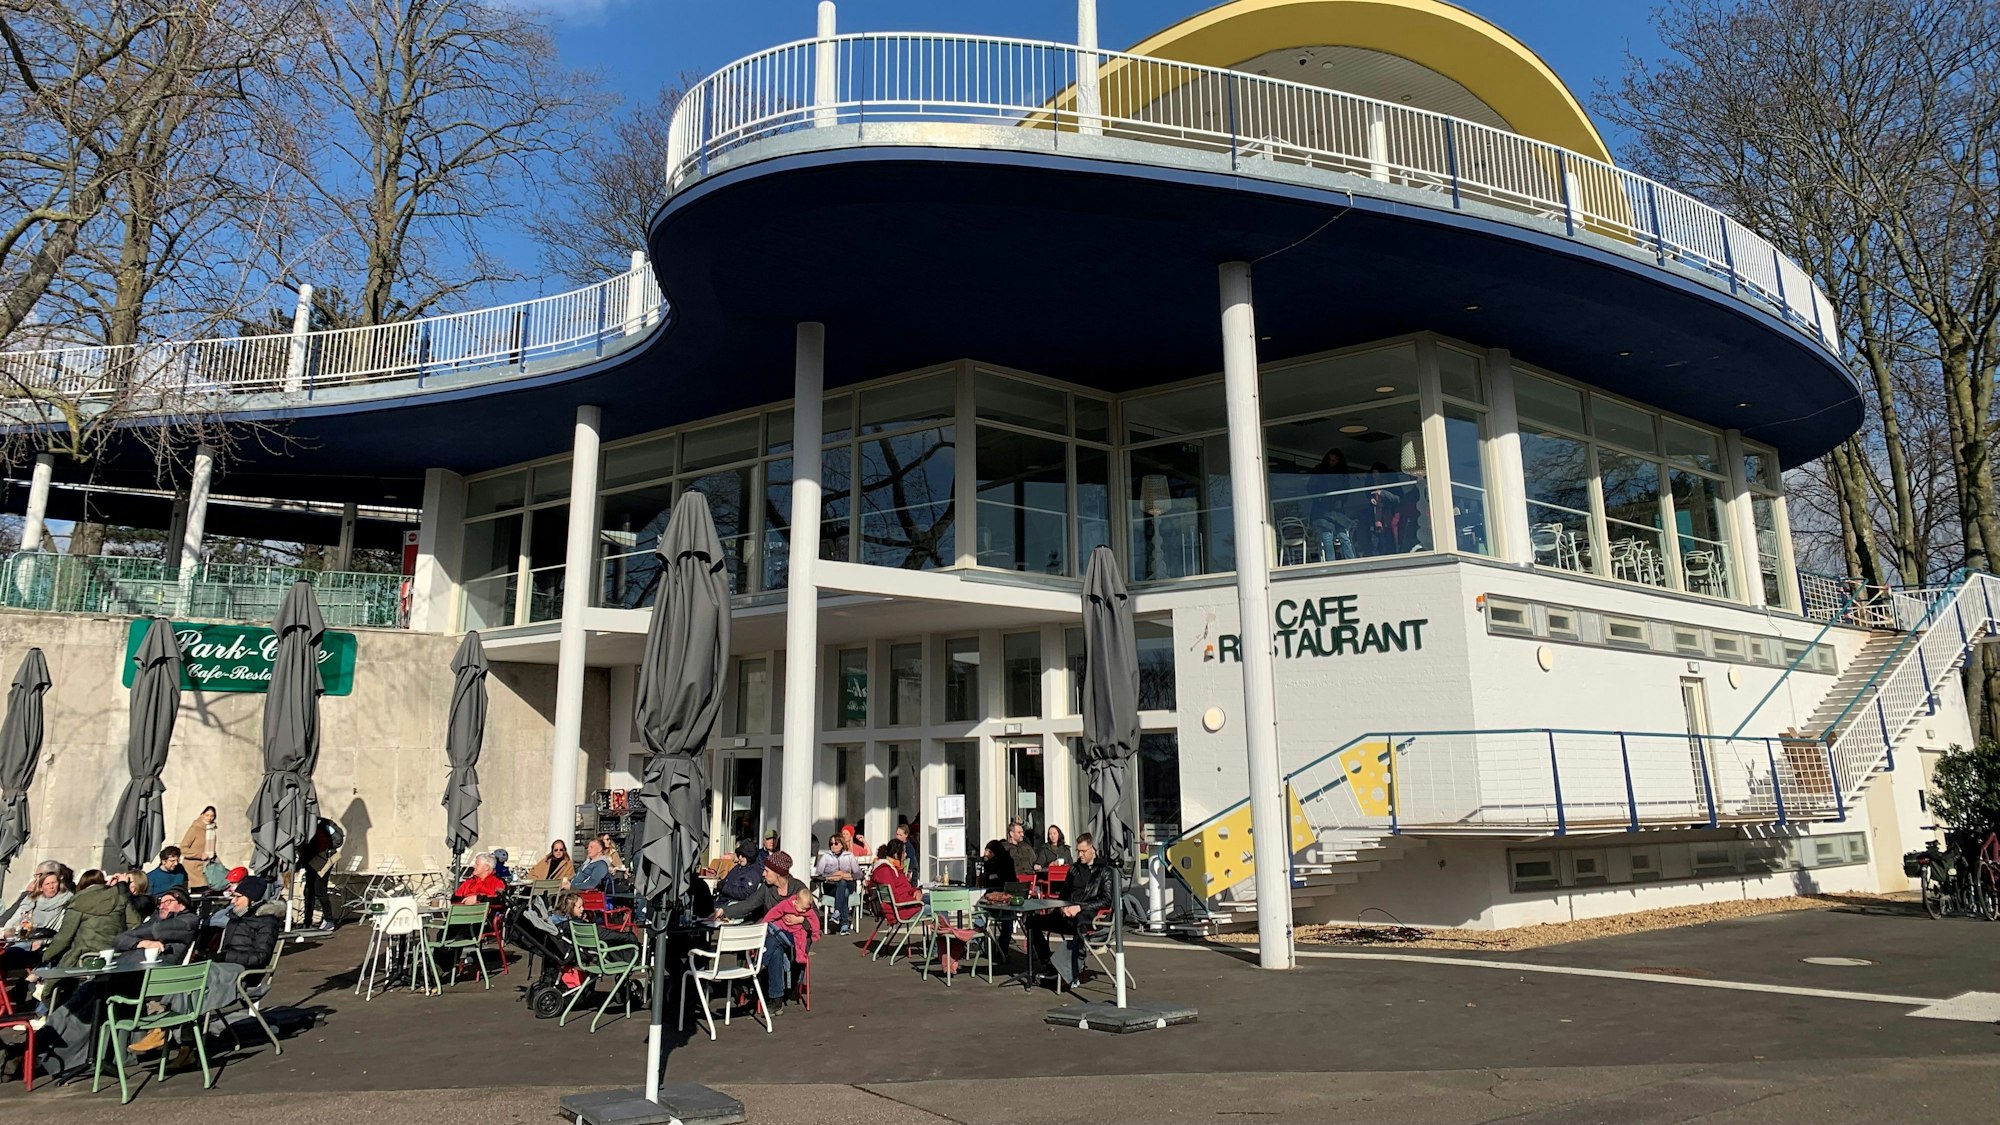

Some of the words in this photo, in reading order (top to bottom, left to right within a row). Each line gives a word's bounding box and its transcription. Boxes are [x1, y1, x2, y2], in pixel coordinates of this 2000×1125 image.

[1275, 594, 1361, 629] CAFE
[175, 629, 335, 664] Park-Ce
[1218, 618, 1429, 664] RTAURANT
[186, 663, 272, 684] Cafe-Resta
